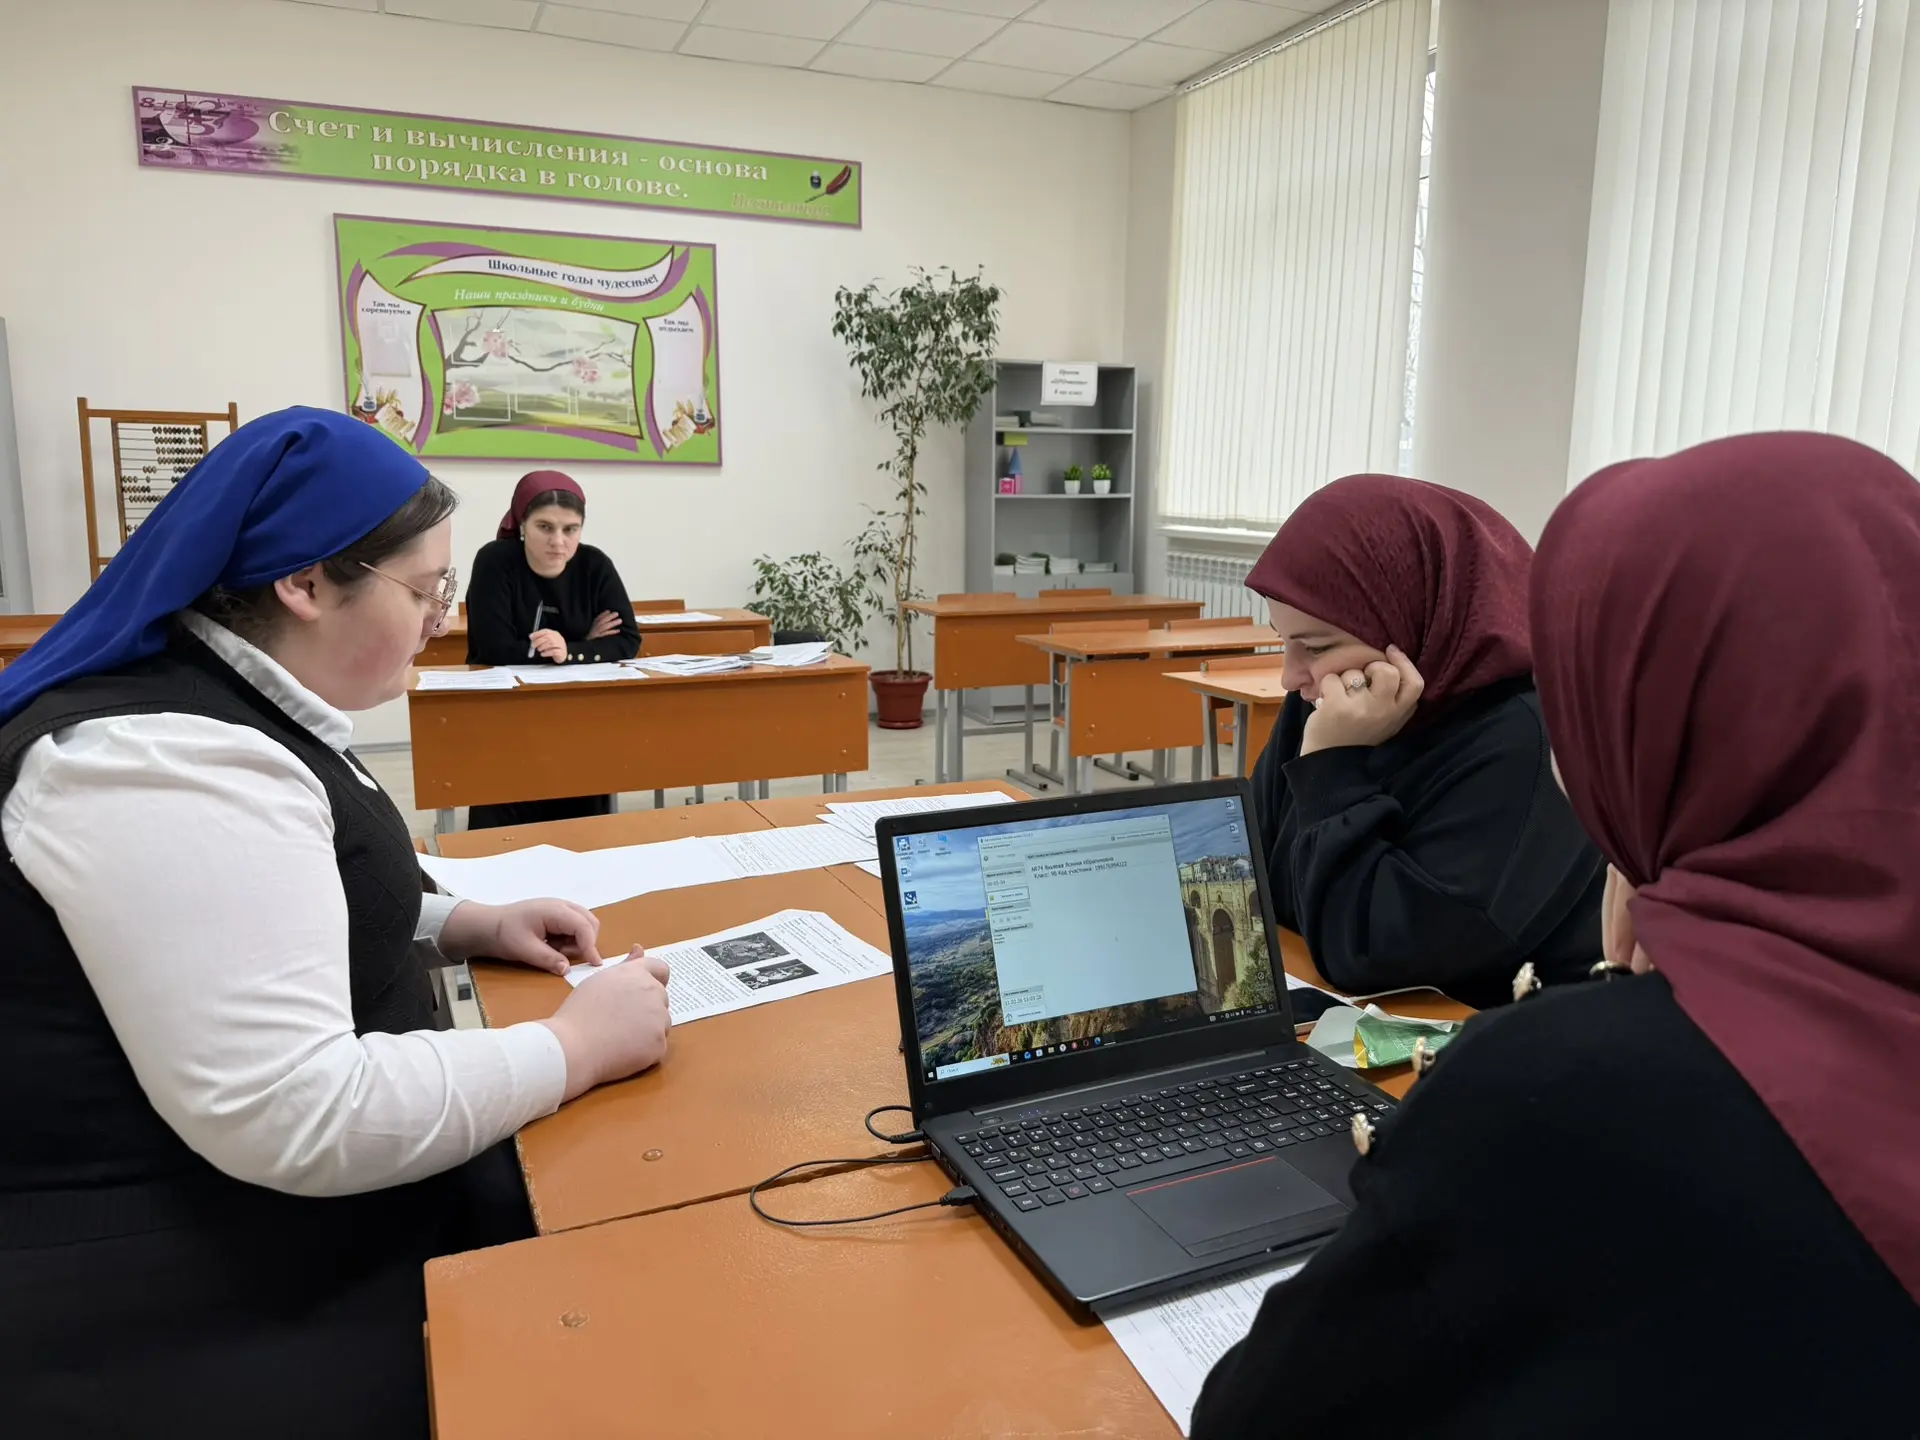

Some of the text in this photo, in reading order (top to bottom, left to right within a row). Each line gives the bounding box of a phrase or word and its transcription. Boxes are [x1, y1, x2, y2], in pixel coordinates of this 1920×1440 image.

[268, 111, 360, 140] Счет
[371, 124, 394, 144] и
[406, 128, 629, 166] вычисления
[658, 155, 768, 181] основа
[372, 153, 689, 199] порядка в голове.
[488, 259, 659, 290] Школьные годы чудесные!
[454, 288, 605, 313] Наши праздники и будни
